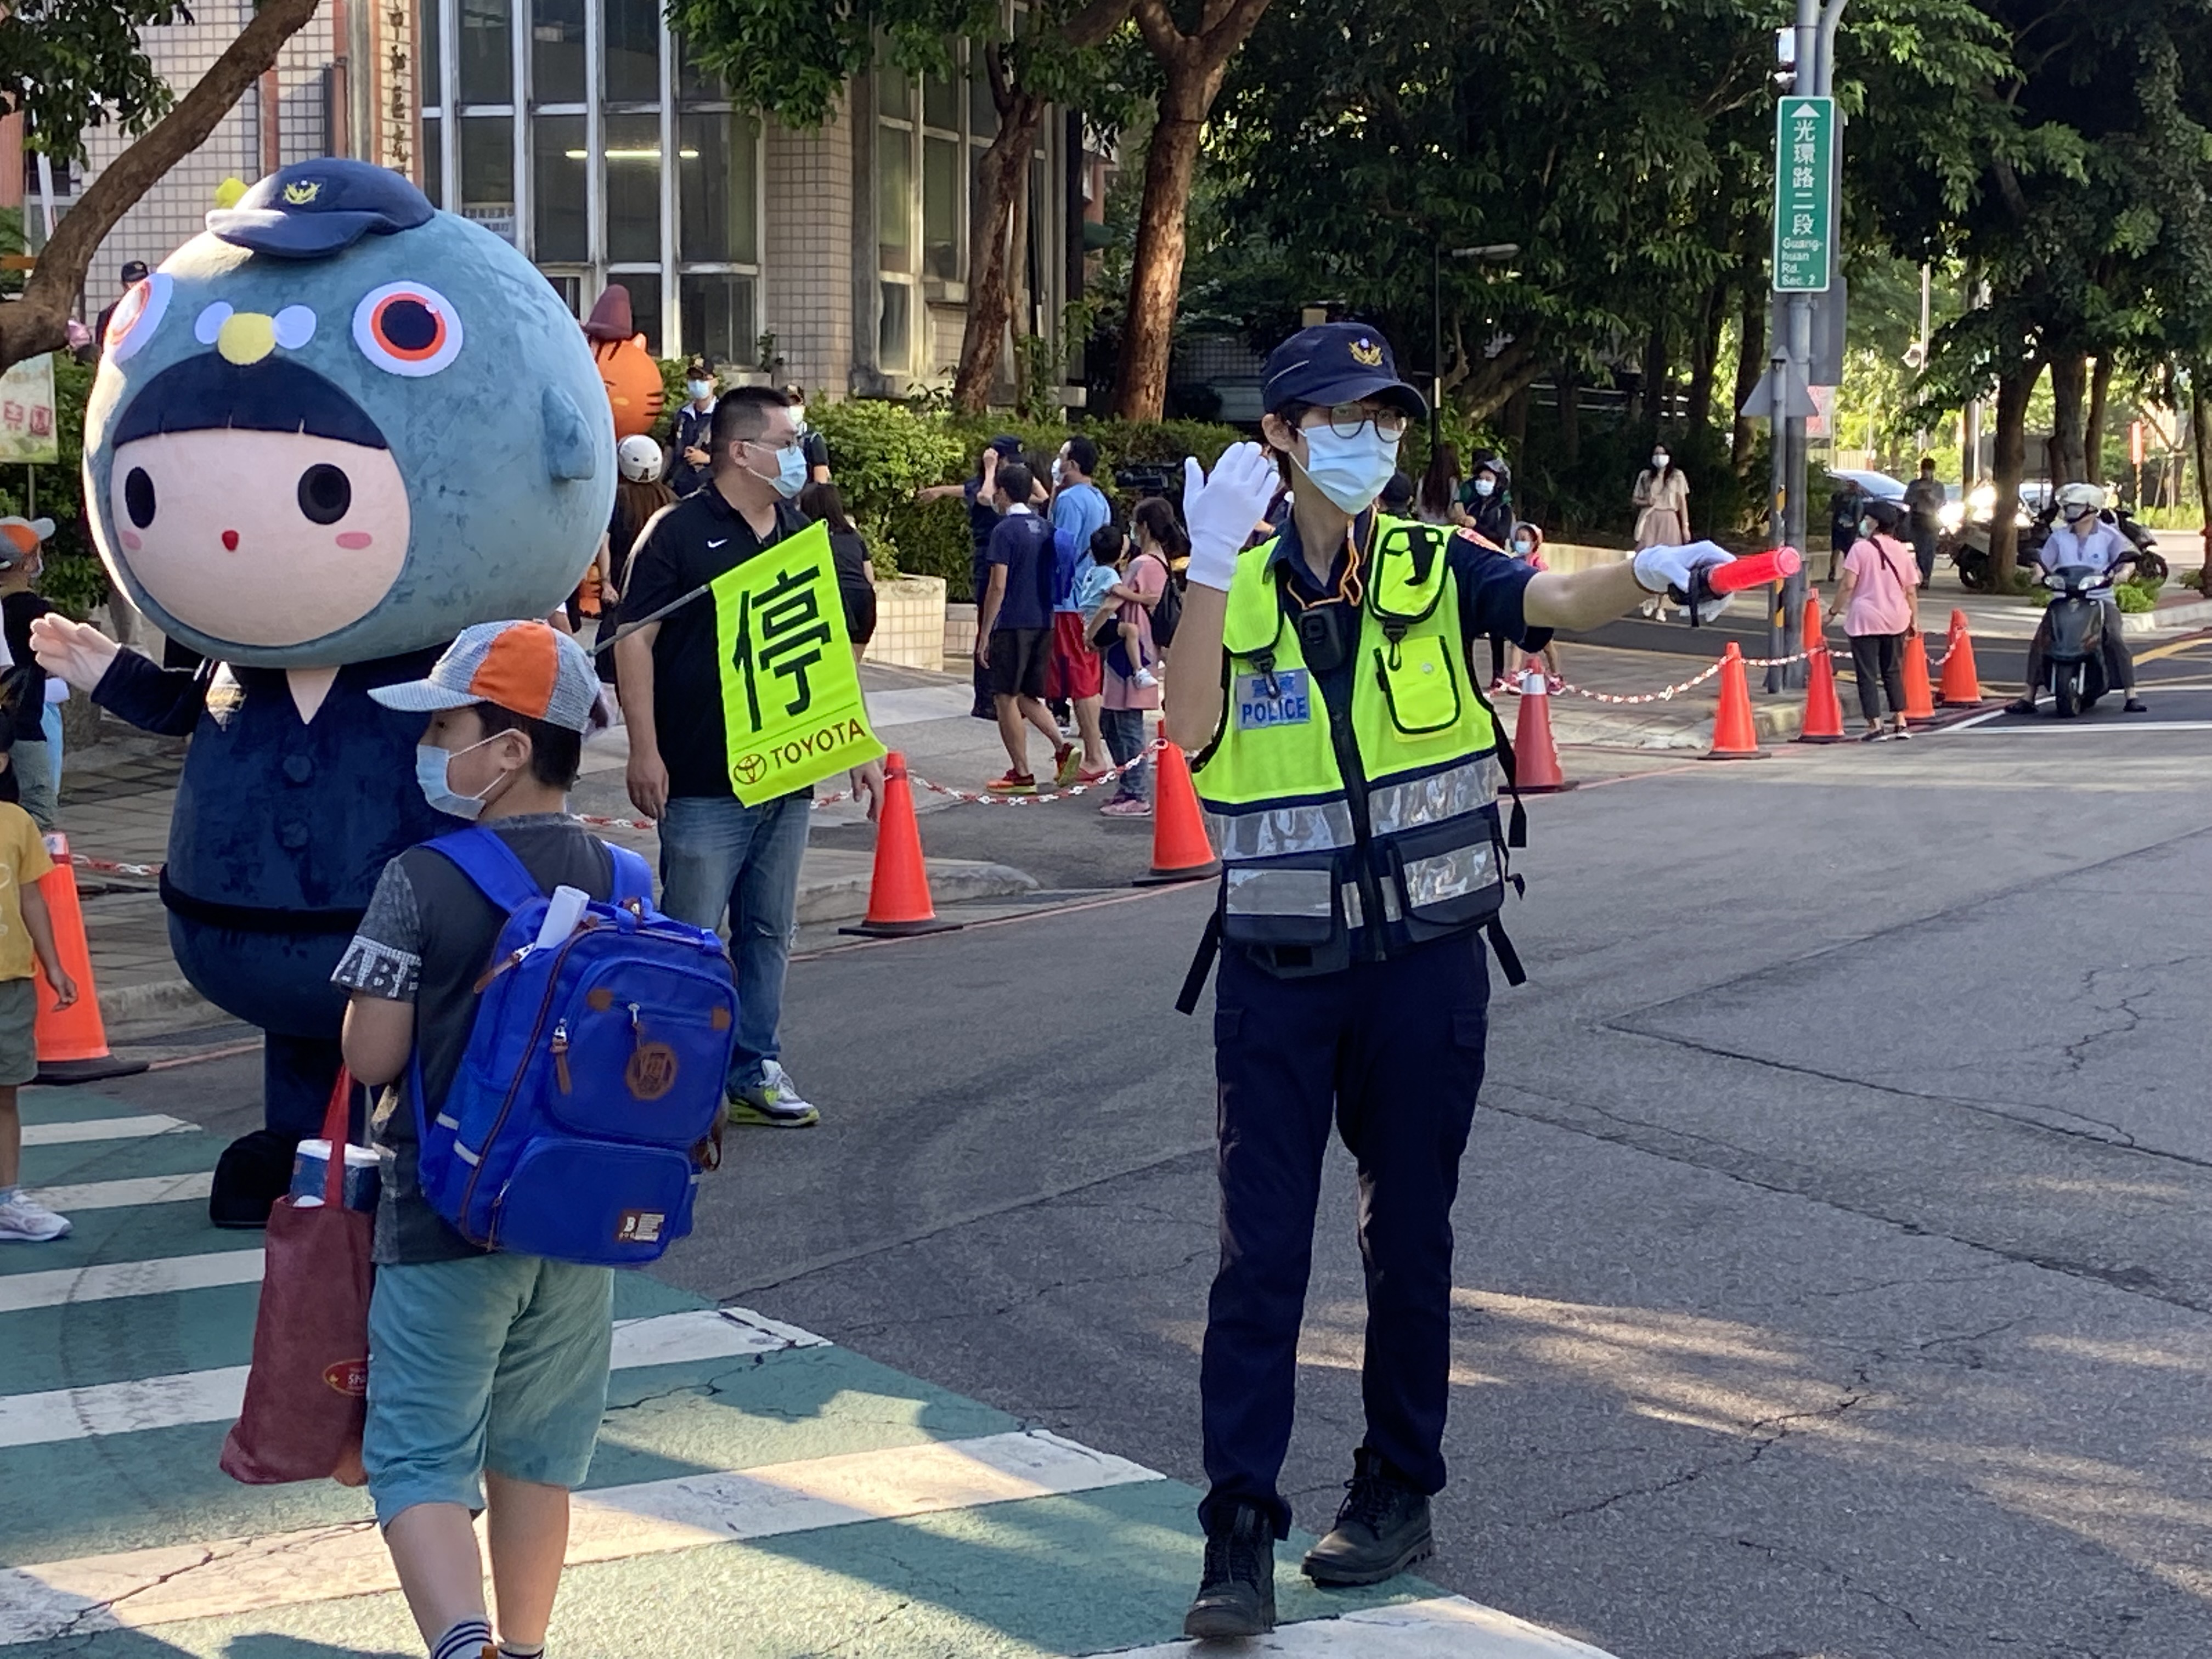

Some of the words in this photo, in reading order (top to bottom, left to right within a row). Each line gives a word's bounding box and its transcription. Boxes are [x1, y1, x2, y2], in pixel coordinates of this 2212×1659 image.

[1792, 119, 1816, 235] 光環路二段
[1781, 250, 1810, 261] huan
[1781, 262, 1801, 274] Rd.
[1781, 274, 1805, 286] Sec.
[1808, 274, 1816, 286] 2
[732, 564, 832, 732] 停
[1242, 696, 1307, 725] POLICE
[770, 718, 866, 769] TOYOTA
